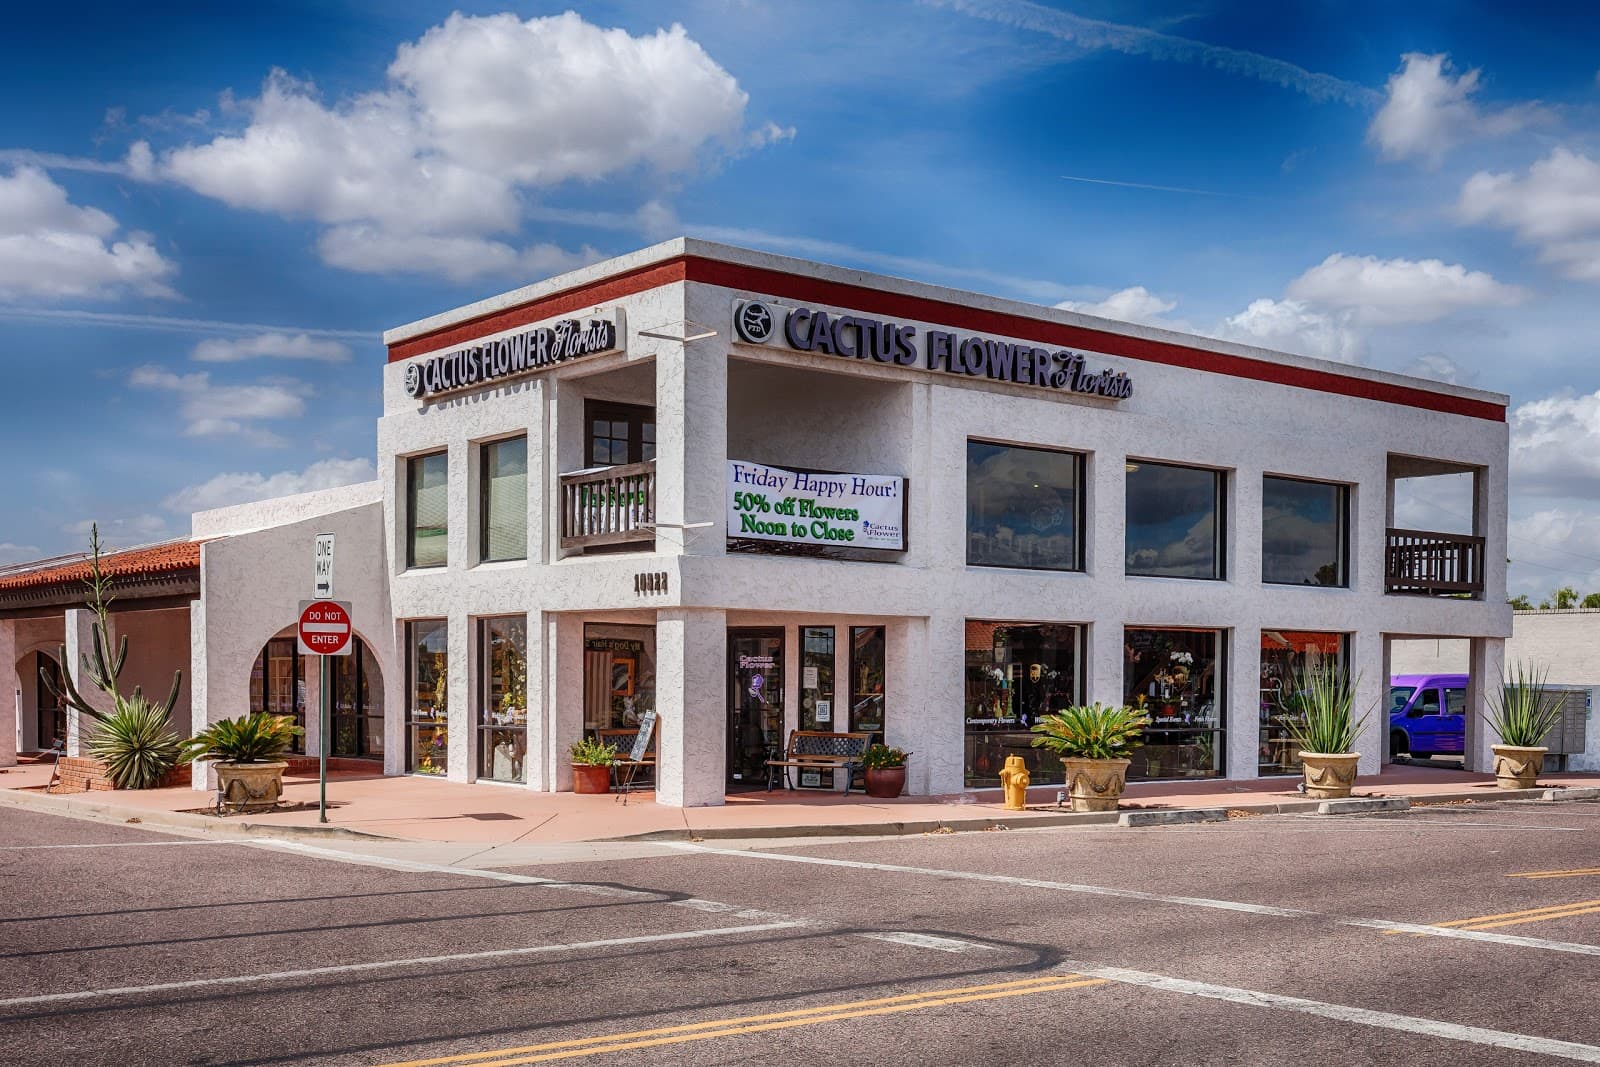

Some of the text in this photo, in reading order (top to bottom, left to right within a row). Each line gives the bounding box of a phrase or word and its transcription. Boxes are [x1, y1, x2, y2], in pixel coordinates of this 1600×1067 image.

[423, 319, 613, 393] CACTUS FLOWER Florists
[787, 308, 1133, 399] CACTUS FLOWER Florists
[733, 464, 898, 498] Friday Happy Hour!
[733, 492, 860, 521] 50% off Flowers
[740, 513, 855, 541] Noon to Close
[867, 529, 899, 537] Flower
[870, 523, 899, 531] Cactus
[317, 541, 331, 556] ONE
[316, 560, 331, 576] WAY
[309, 611, 341, 621] DO NOT
[311, 635, 339, 644] ENTER
